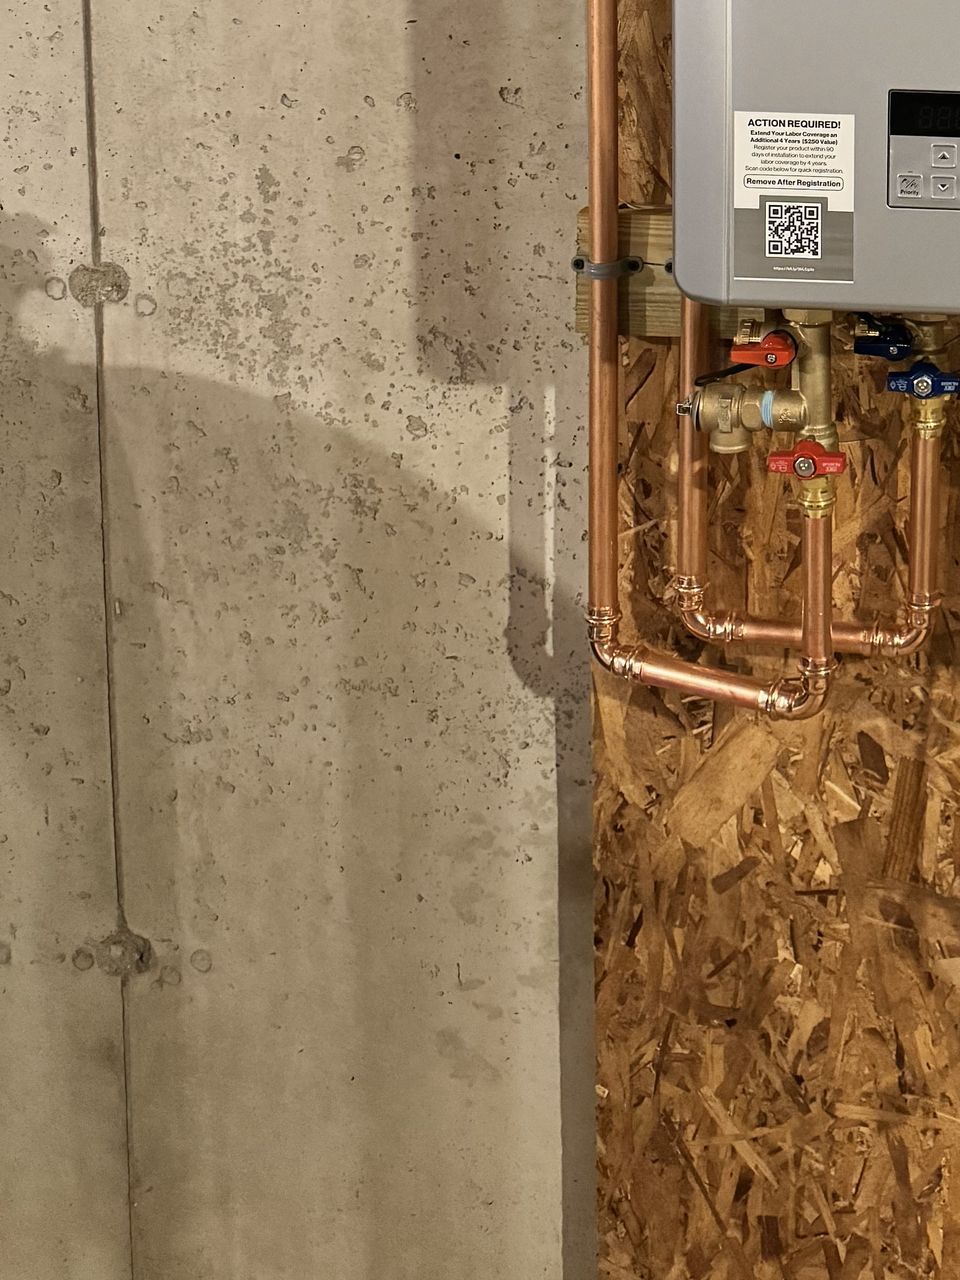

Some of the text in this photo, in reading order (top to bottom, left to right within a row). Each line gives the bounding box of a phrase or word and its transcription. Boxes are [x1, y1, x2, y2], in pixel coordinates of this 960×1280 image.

[747, 119, 841, 130] ACTION REQUIRED!
[777, 178, 796, 186] After
[796, 179, 841, 188] Registration
[900, 189, 919, 197] Priority
